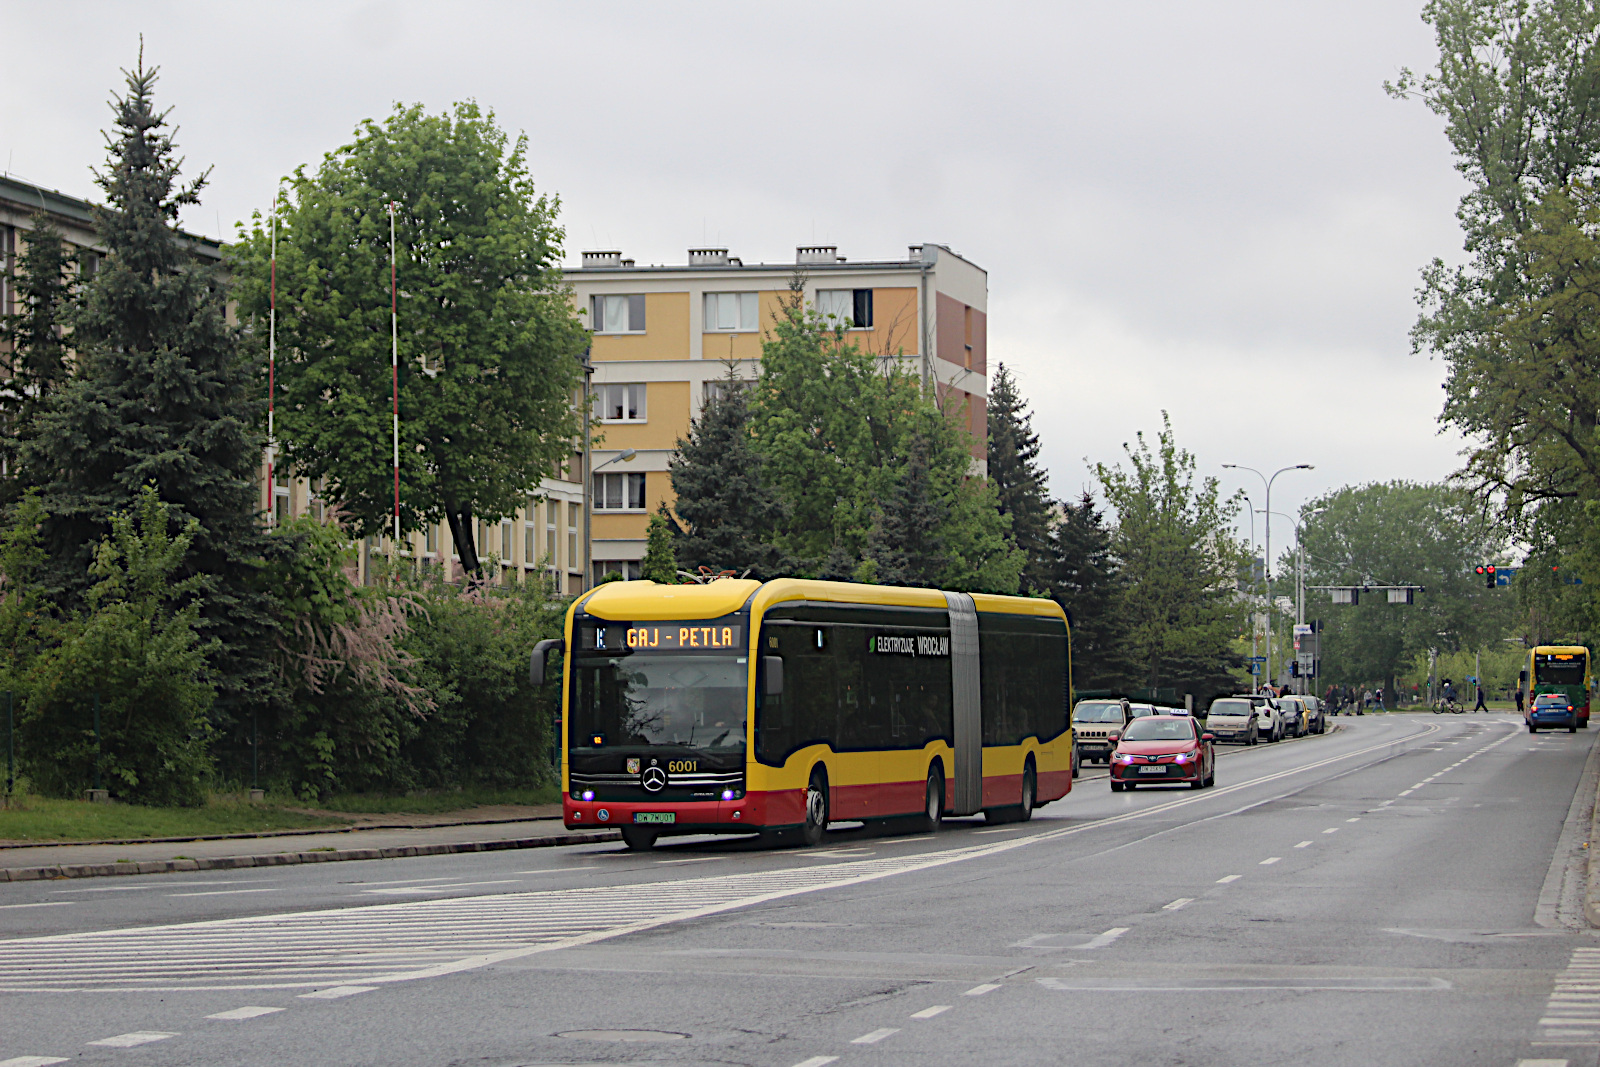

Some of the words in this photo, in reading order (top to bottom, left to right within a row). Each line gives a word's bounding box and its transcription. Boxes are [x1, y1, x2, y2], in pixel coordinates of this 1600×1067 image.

[596, 628, 606, 648] K
[627, 628, 659, 647] GAJ
[878, 636, 915, 657] ELEKTRYZUJĘ
[917, 636, 949, 655] WROCŁAW
[668, 760, 697, 772] 6001
